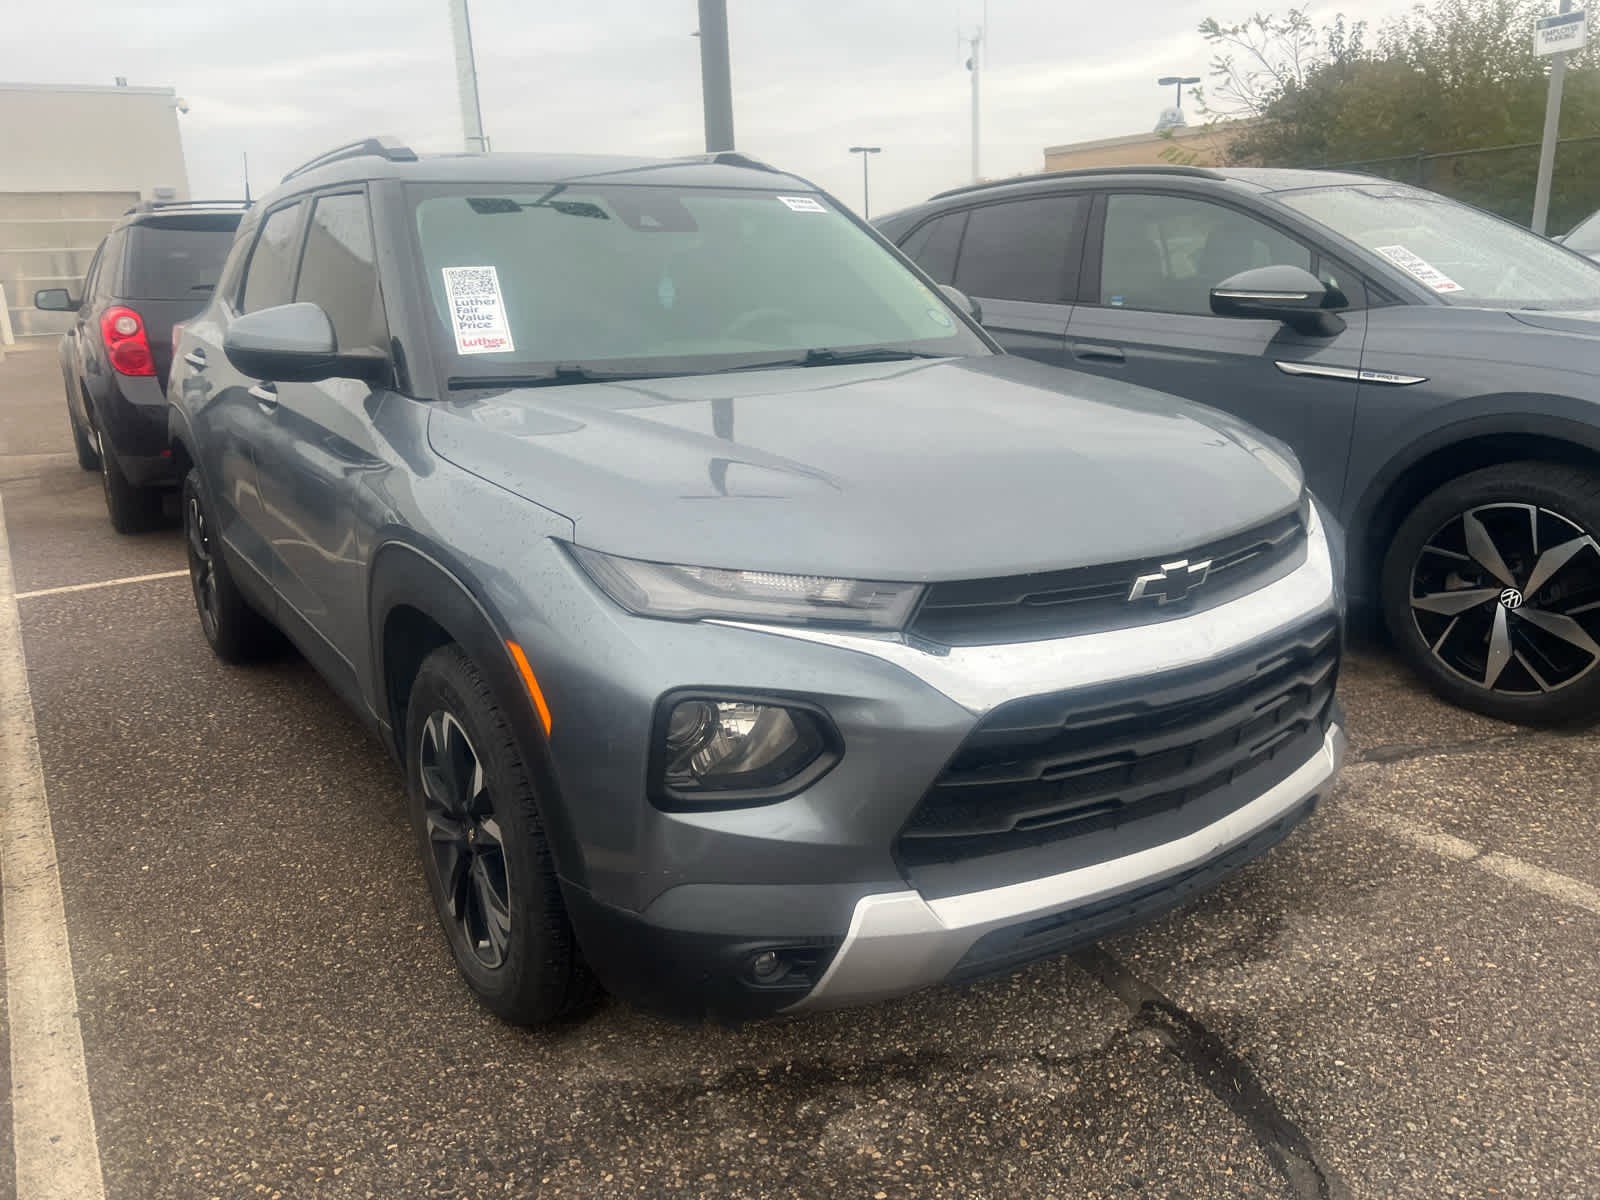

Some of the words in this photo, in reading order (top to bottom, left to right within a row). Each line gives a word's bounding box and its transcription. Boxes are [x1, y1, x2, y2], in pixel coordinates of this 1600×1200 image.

[455, 298, 496, 307] Luther
[456, 306, 480, 314] Fair
[457, 314, 494, 322] Value
[459, 321, 493, 330] Price
